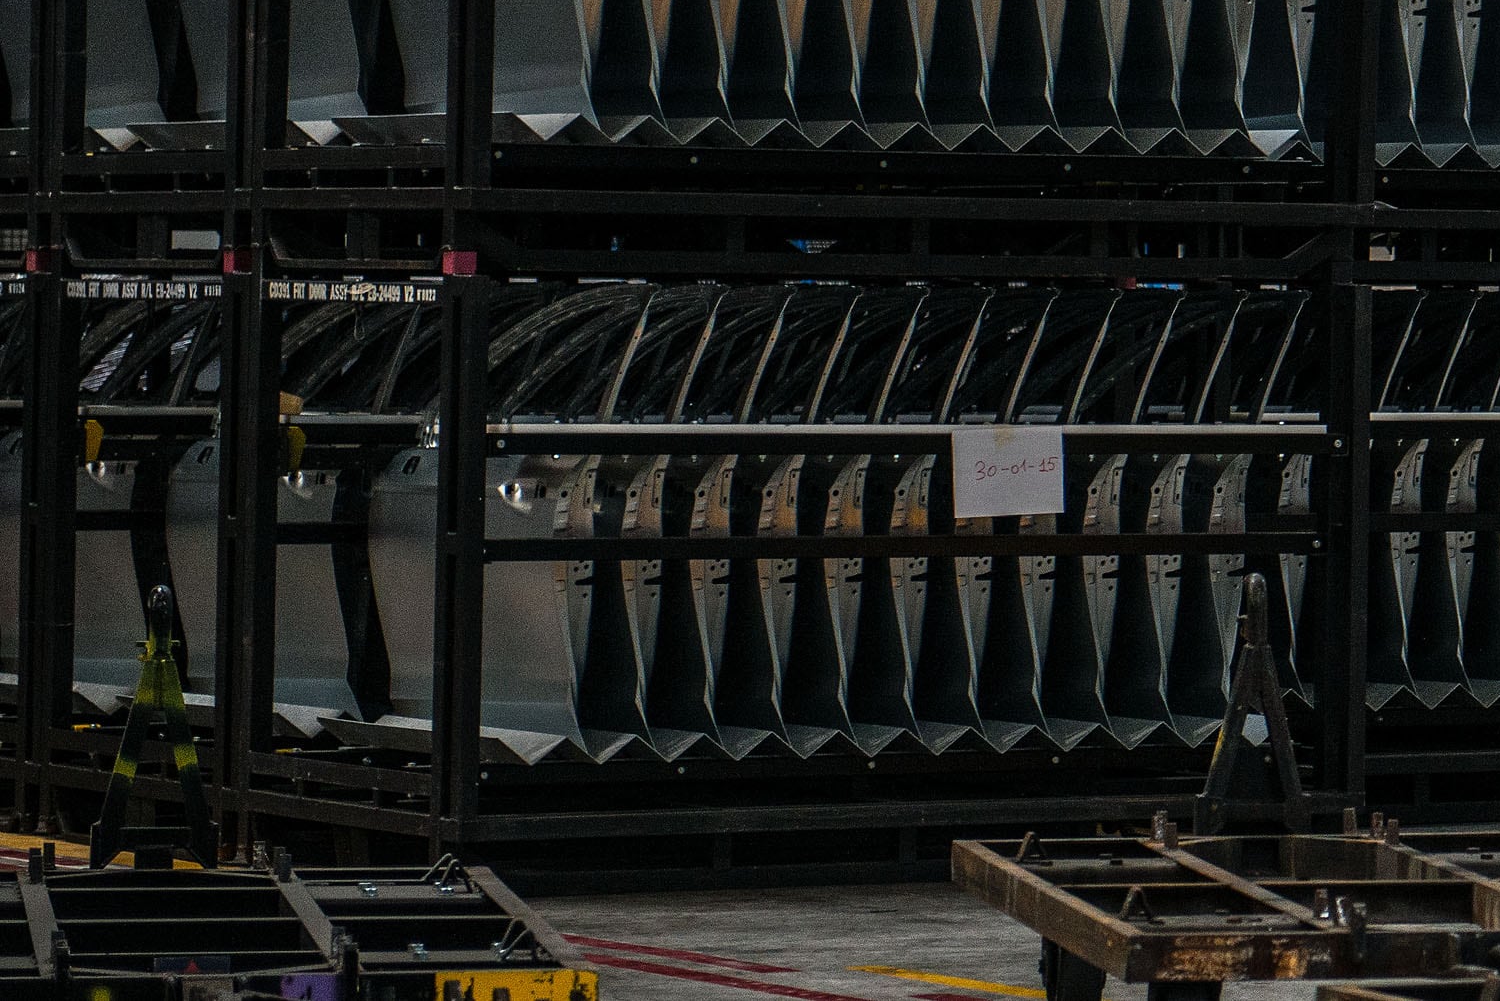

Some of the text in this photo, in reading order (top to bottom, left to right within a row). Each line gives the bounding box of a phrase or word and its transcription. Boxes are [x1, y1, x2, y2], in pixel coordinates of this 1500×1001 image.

[67, 282, 86, 298] CD391
[88, 282, 100, 298] FRT
[102, 282, 119, 298] DOOR
[122, 283, 138, 299] ASSY
[141, 283, 152, 299] R/L
[156, 283, 186, 299] EB-24499
[188, 284, 197, 299] V2
[269, 282, 290, 299] CD391
[293, 283, 305, 299] FRT
[308, 283, 327, 300] DOOR
[330, 284, 348, 301] ASSY
[404, 285, 414, 303] V2
[975, 456, 1058, 481] 30-01-15
